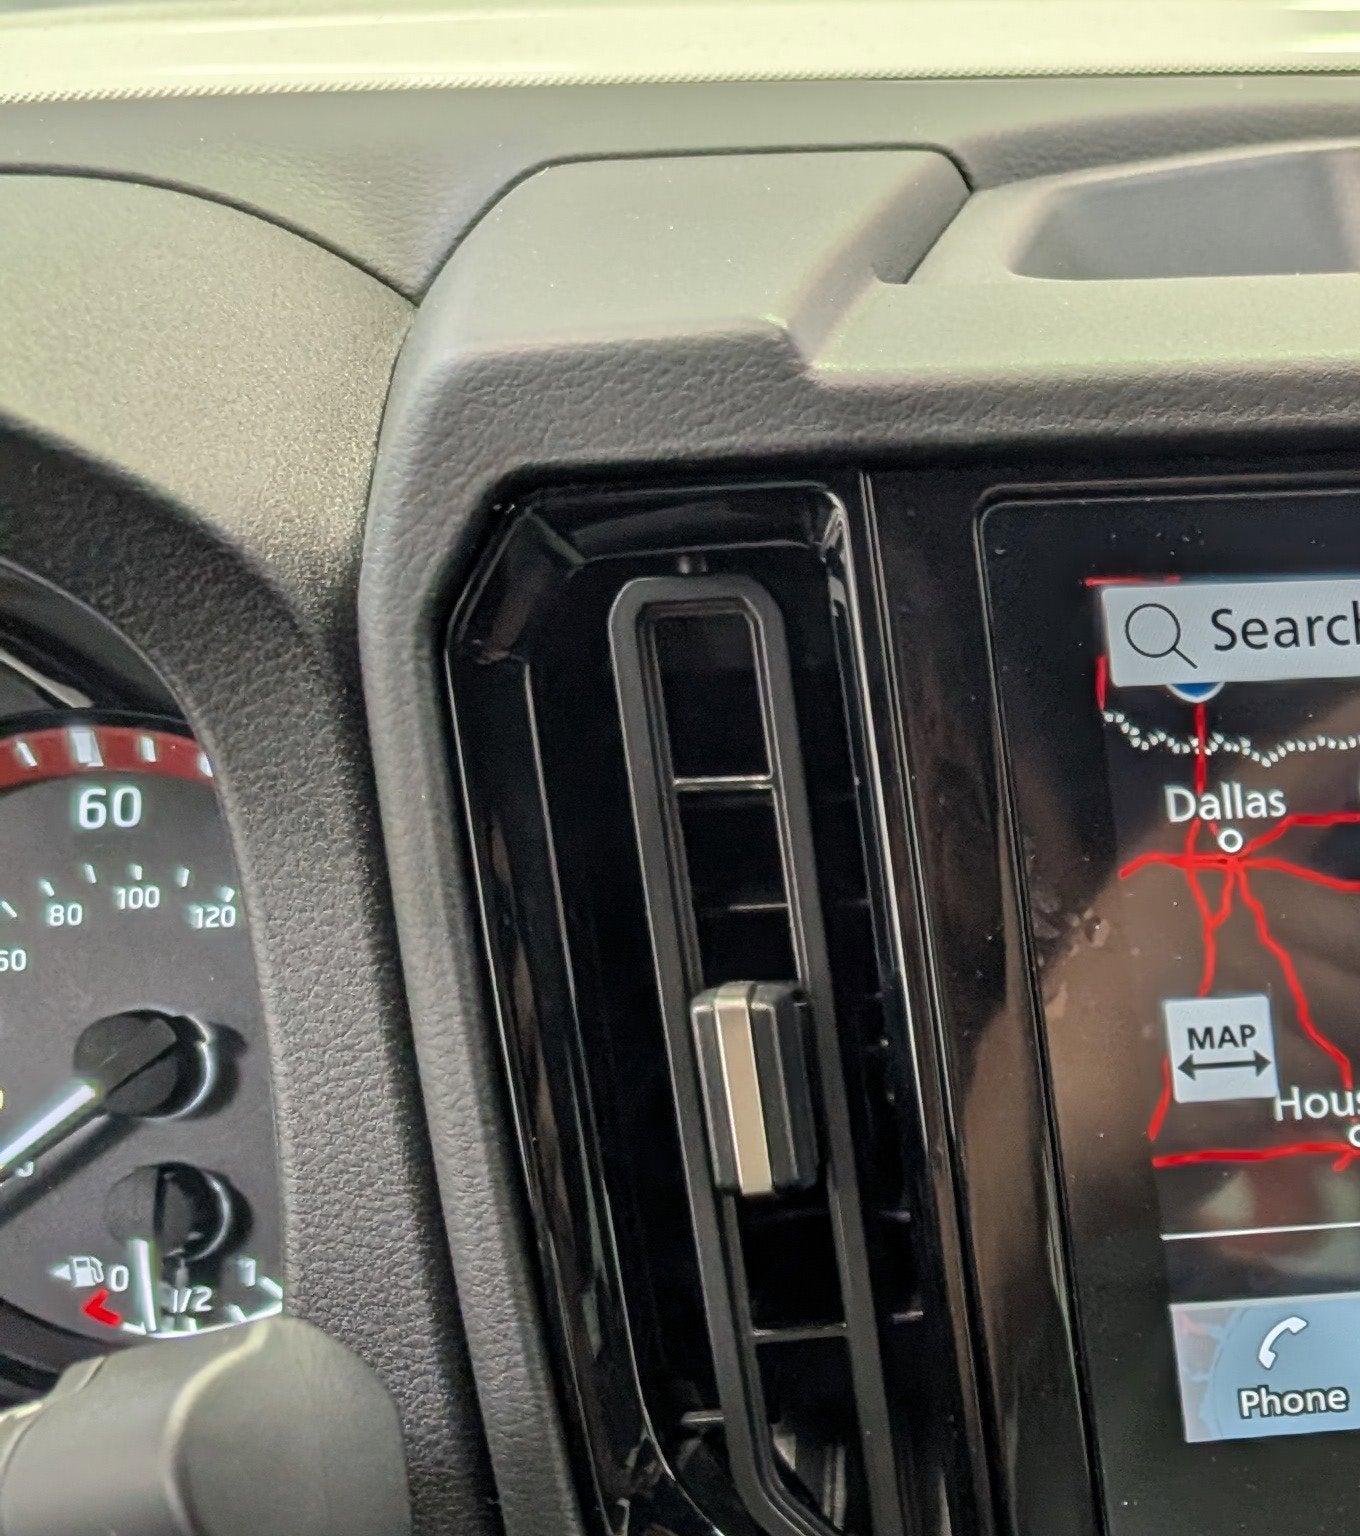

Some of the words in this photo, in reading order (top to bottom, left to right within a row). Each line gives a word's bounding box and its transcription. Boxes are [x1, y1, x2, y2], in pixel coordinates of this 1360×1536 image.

[77, 785, 142, 829] 60
[1165, 784, 1288, 823] Dallas
[118, 885, 160, 910] 100
[49, 903, 83, 927] 80
[192, 905, 236, 929] 120
[1186, 1024, 1257, 1051] MAP
[108, 1264, 129, 1293] 0
[168, 1285, 213, 1314] 1/2
[1238, 1384, 1349, 1420] Phone
